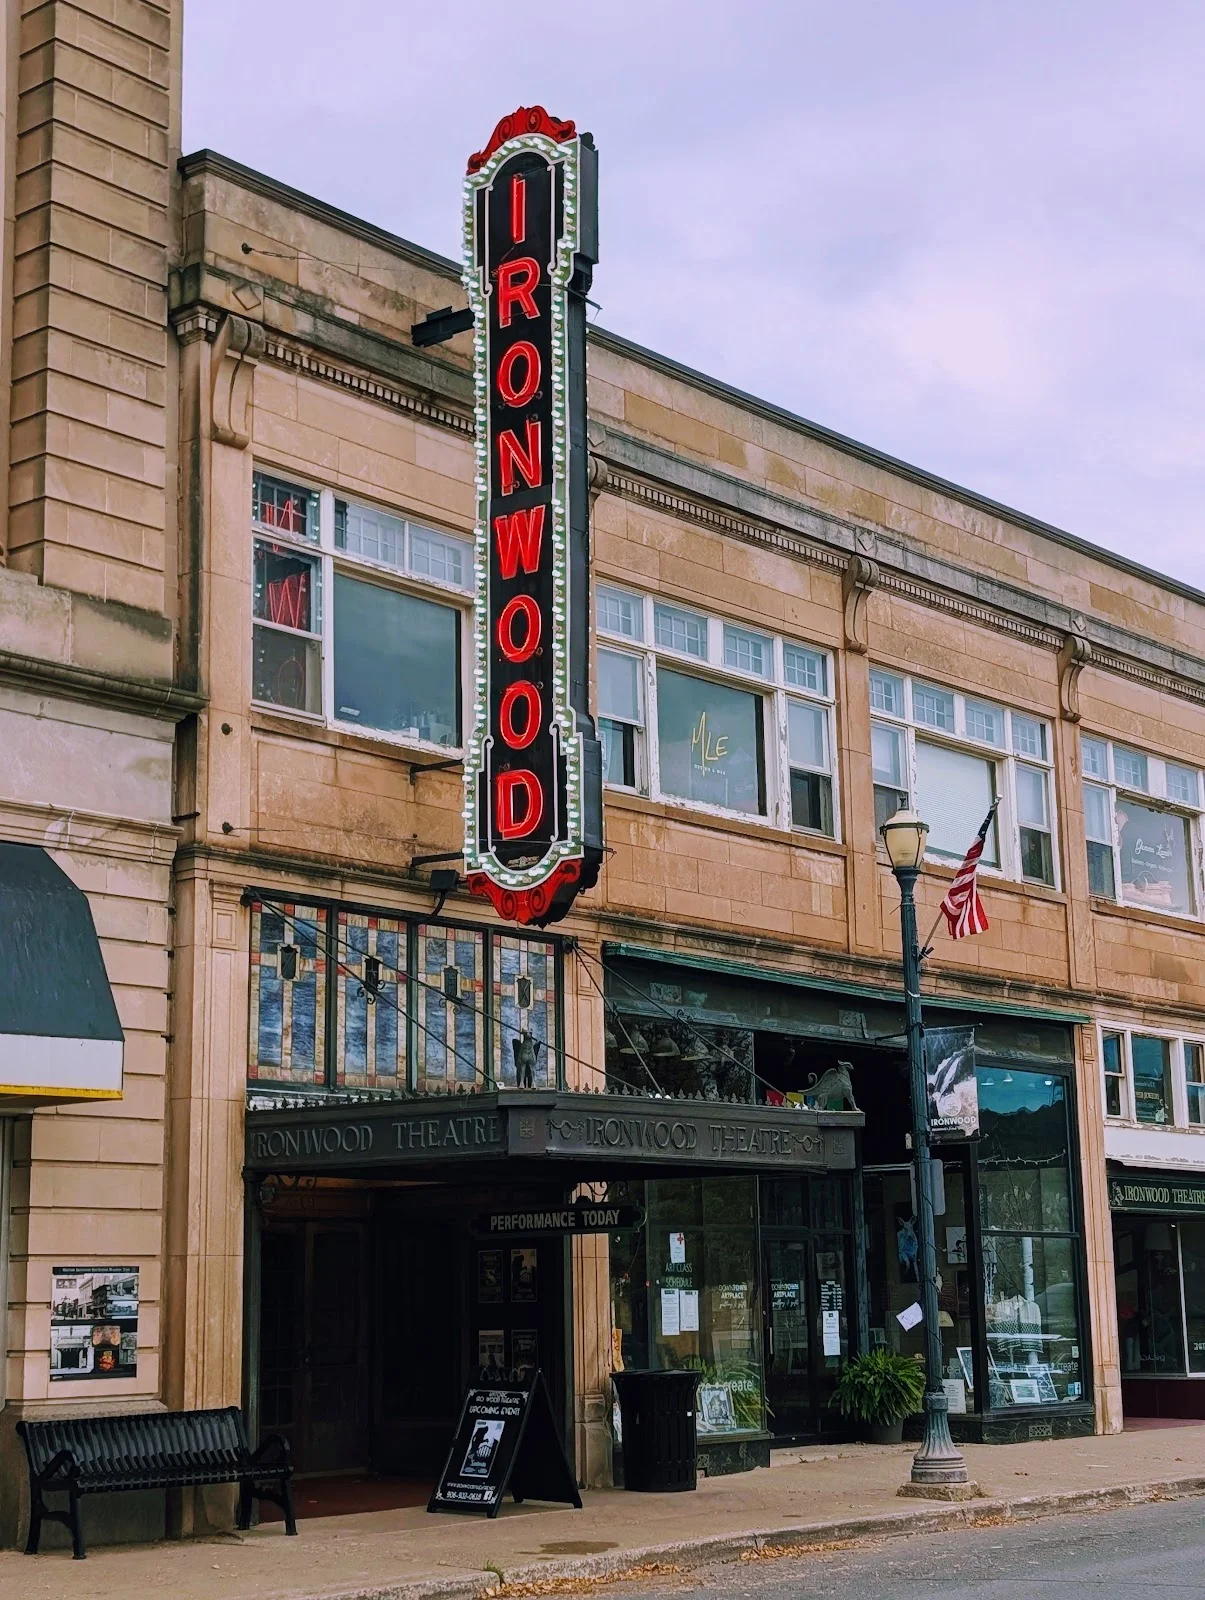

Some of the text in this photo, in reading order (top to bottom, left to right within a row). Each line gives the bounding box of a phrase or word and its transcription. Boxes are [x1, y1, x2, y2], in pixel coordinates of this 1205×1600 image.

[495, 173, 545, 839] IRONWOOD
[931, 1116, 976, 1126] IRONWOOD
[392, 1116, 499, 1149] THEATRE
[586, 1117, 792, 1156] IRONWOOD THEATRE
[1125, 1185, 1169, 1204] IRONWOOD
[490, 1209, 620, 1231] PERFORMANCE TODAY
[665, 1262, 693, 1273] ART CLASS
[665, 1276, 693, 1288] SCHEDULE
[469, 1405, 500, 1415] UPCOMING
